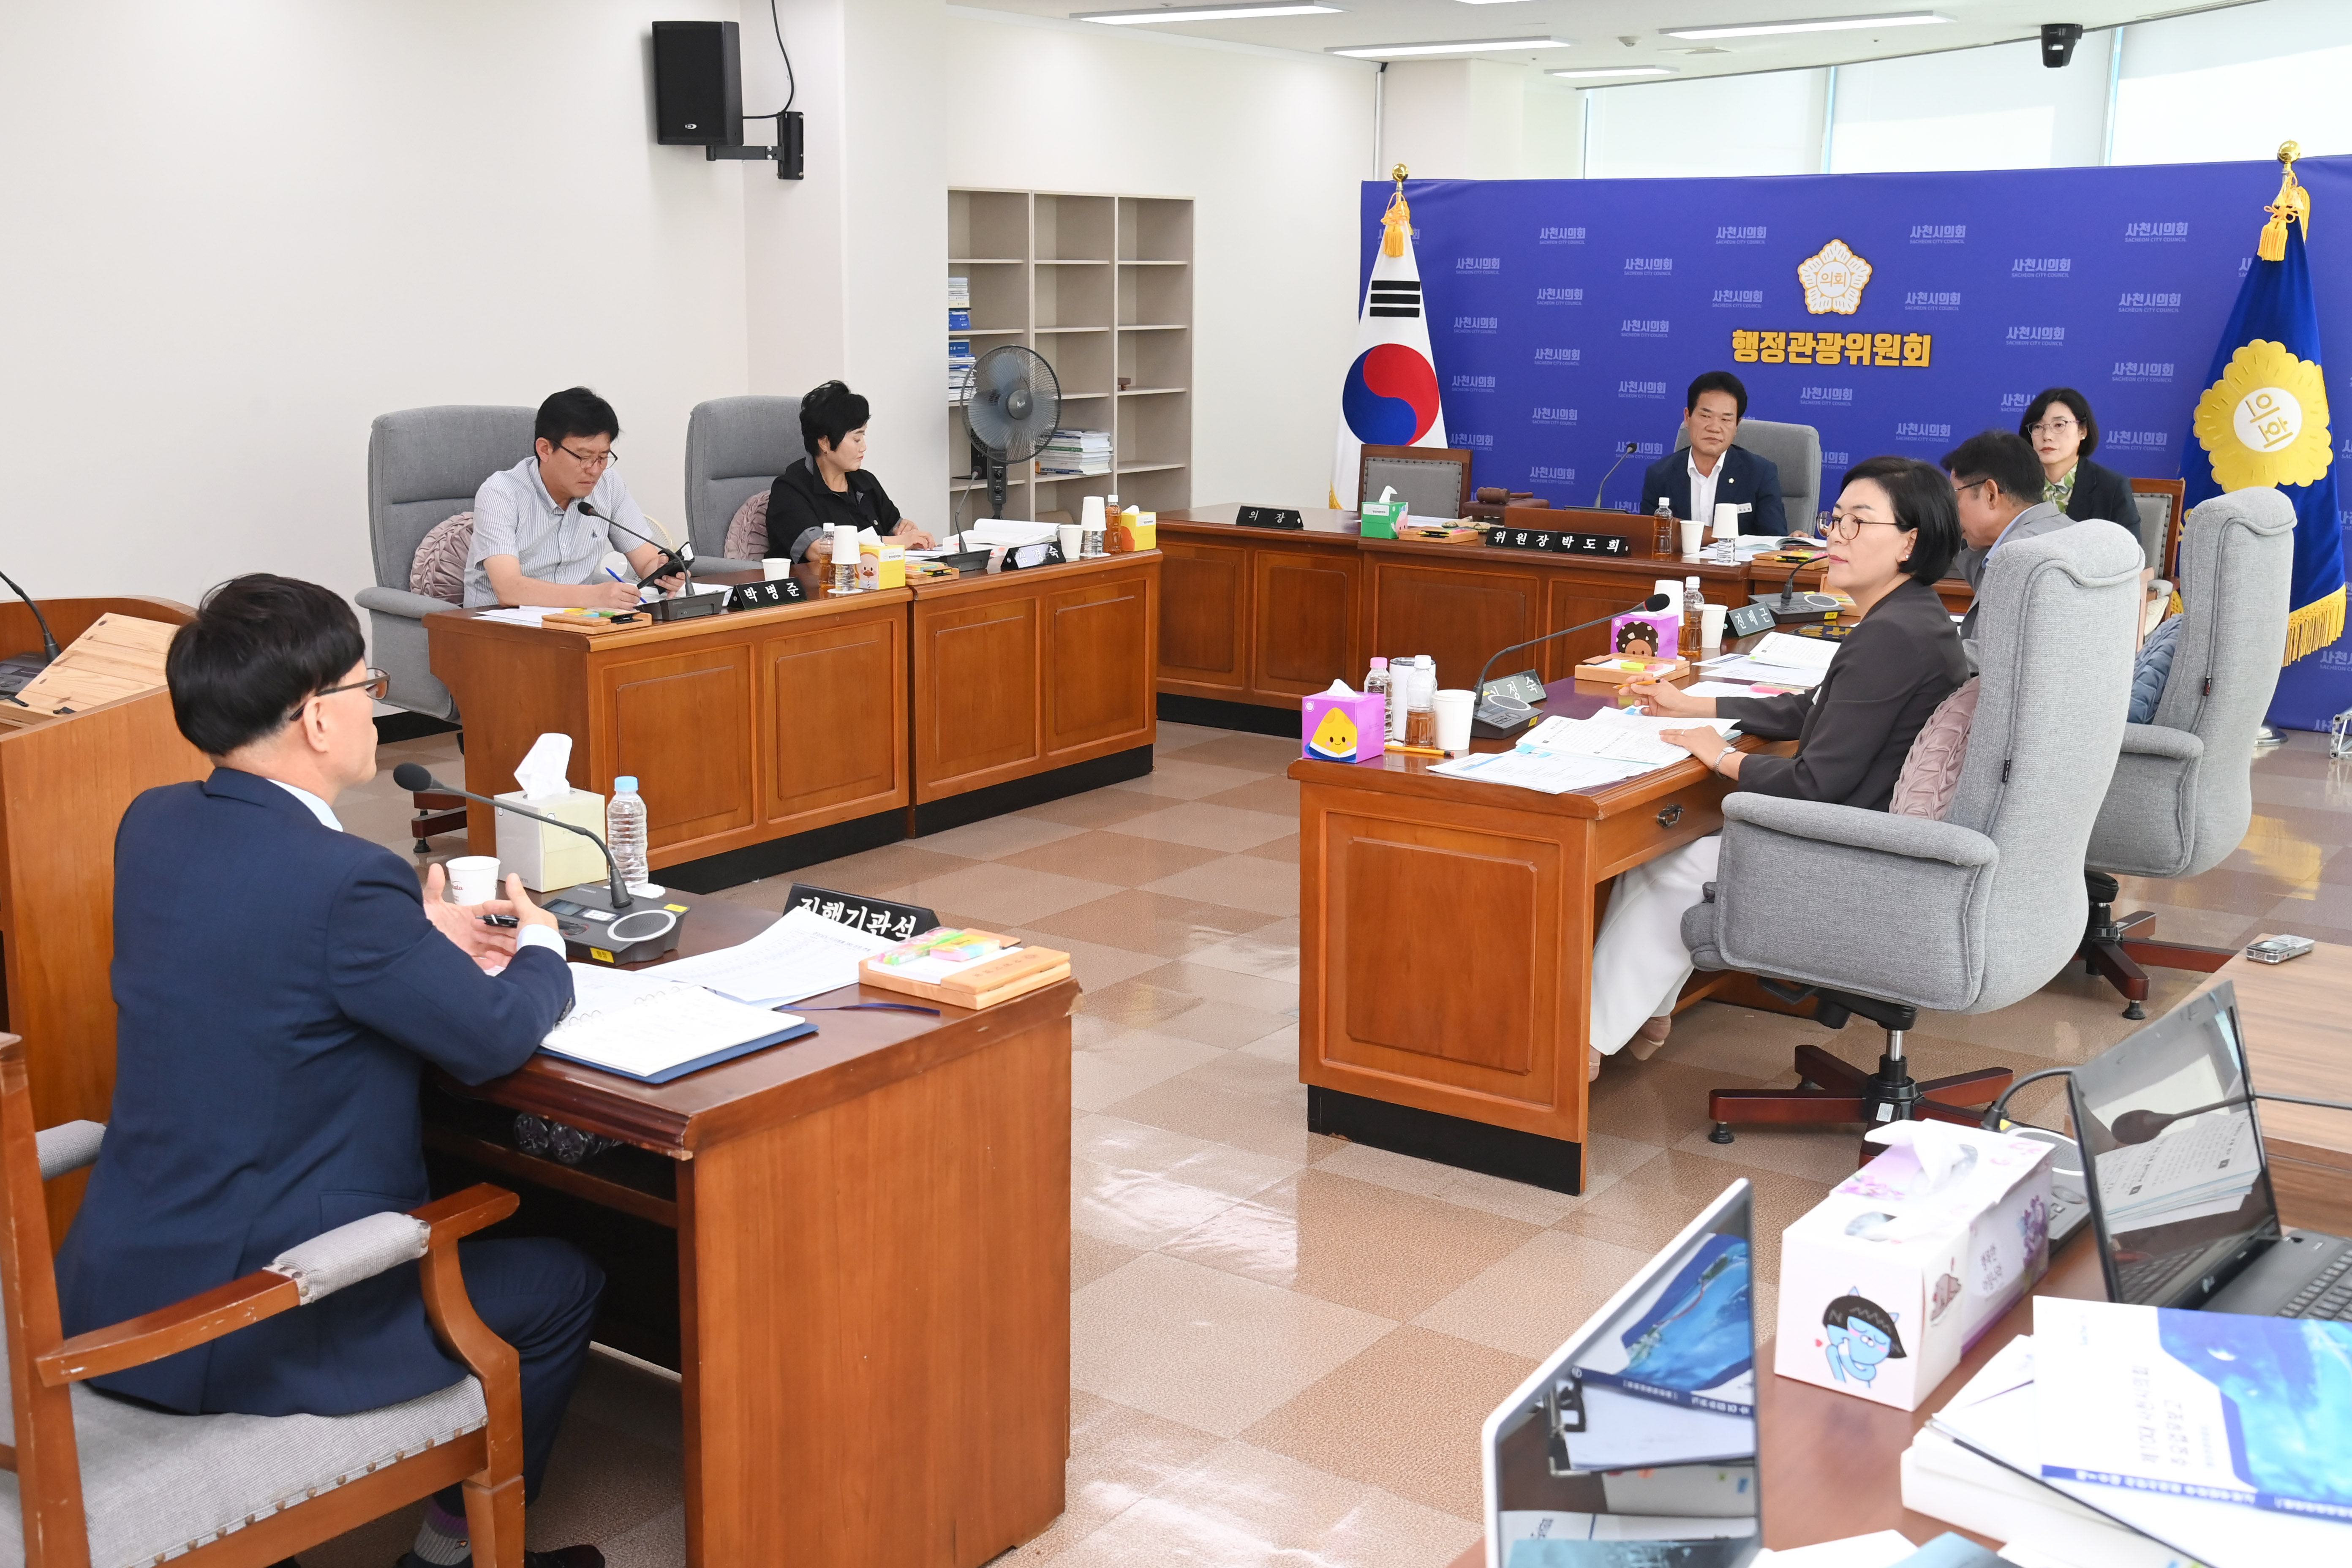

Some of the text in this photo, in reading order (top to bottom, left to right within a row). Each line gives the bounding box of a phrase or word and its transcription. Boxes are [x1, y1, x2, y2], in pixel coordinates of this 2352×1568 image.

[1539, 226, 1586, 240] 사천시의회
[1715, 226, 1767, 239] 사천시의회
[1909, 224, 1966, 238] 사천시의회
[2125, 221, 2189, 236] 사천시의회
[1455, 257, 1500, 270] 사천시의회
[1624, 257, 1673, 270] 사천시의회
[2011, 258, 2071, 272] 사천시의회
[1820, 271, 1846, 288] 의회
[1536, 287, 1583, 300] 사천시의회
[1712, 289, 1763, 303] 사천시의회
[1905, 291, 1961, 305] 사천시의회
[2118, 292, 2181, 307] 사천시의회
[1453, 316, 1498, 329] 사천시의회
[1621, 319, 1669, 333] 사천시의회
[2006, 326, 2065, 340] 사천시의회
[1534, 348, 1580, 361] 사천시의회
[1732, 329, 1931, 367] 행정관광위원회
[2112, 362, 2175, 377] 사천시의회
[1451, 375, 1496, 388] 사천시의회
[1618, 380, 1666, 394] 사천시의회
[1800, 387, 1853, 401] 사천시의회
[1532, 407, 1578, 421] 사천시의회
[2245, 393, 2293, 449] 의회
[1895, 422, 1951, 437] 사천시의회
[1450, 433, 1493, 446] 사천시의회
[2106, 430, 2168, 446] 사천시의회
[1615, 441, 1663, 455] 사시의회
[1529, 466, 1575, 480] 사천시의회
